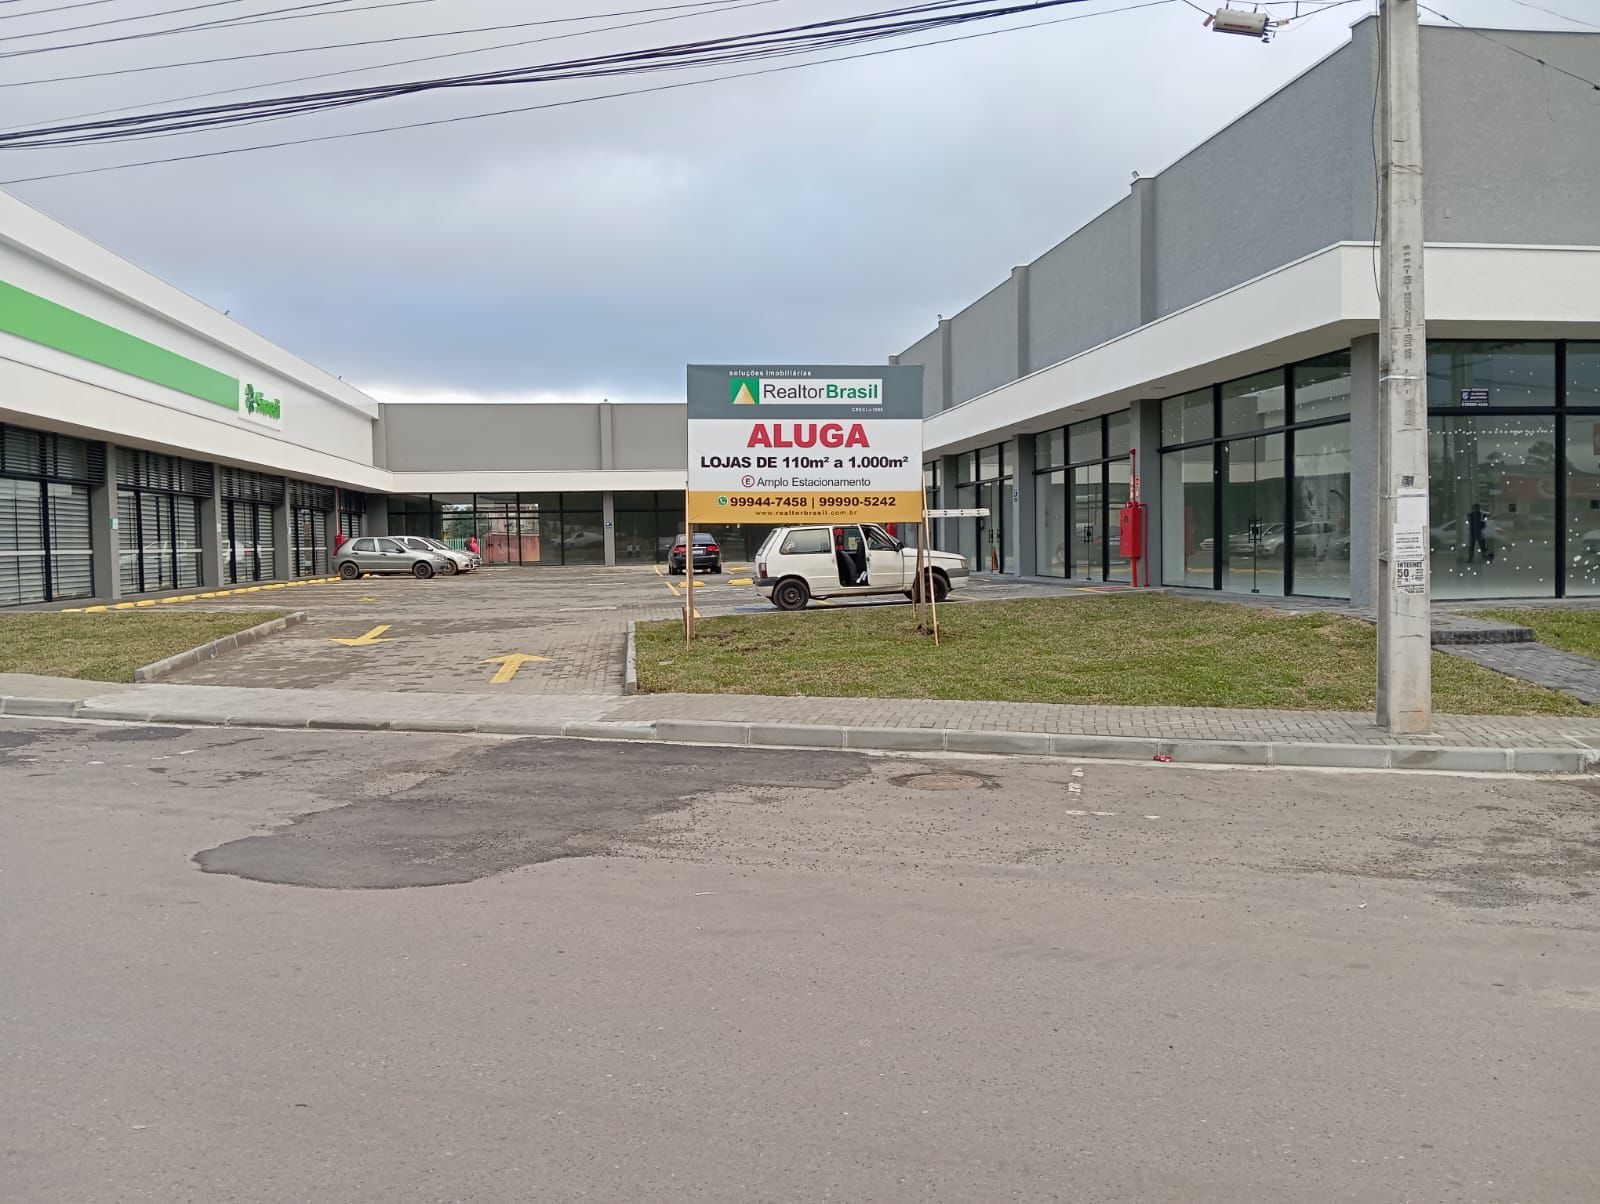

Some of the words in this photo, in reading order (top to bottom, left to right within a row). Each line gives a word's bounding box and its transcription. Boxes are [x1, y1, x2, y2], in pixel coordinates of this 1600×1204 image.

[747, 423, 870, 448] ALUGA
[701, 456, 751, 468] LOJAS
[756, 456, 777, 468] DE
[782, 456, 830, 468] 110m²
[834, 459, 843, 468] a
[848, 456, 909, 468] 1.000m²
[757, 477, 789, 489] Amplo
[791, 477, 871, 487] Estacionamento
[730, 497, 807, 507] 99944-7458
[819, 497, 896, 507] 99990-5242
[1397, 568, 1409, 578] 50
